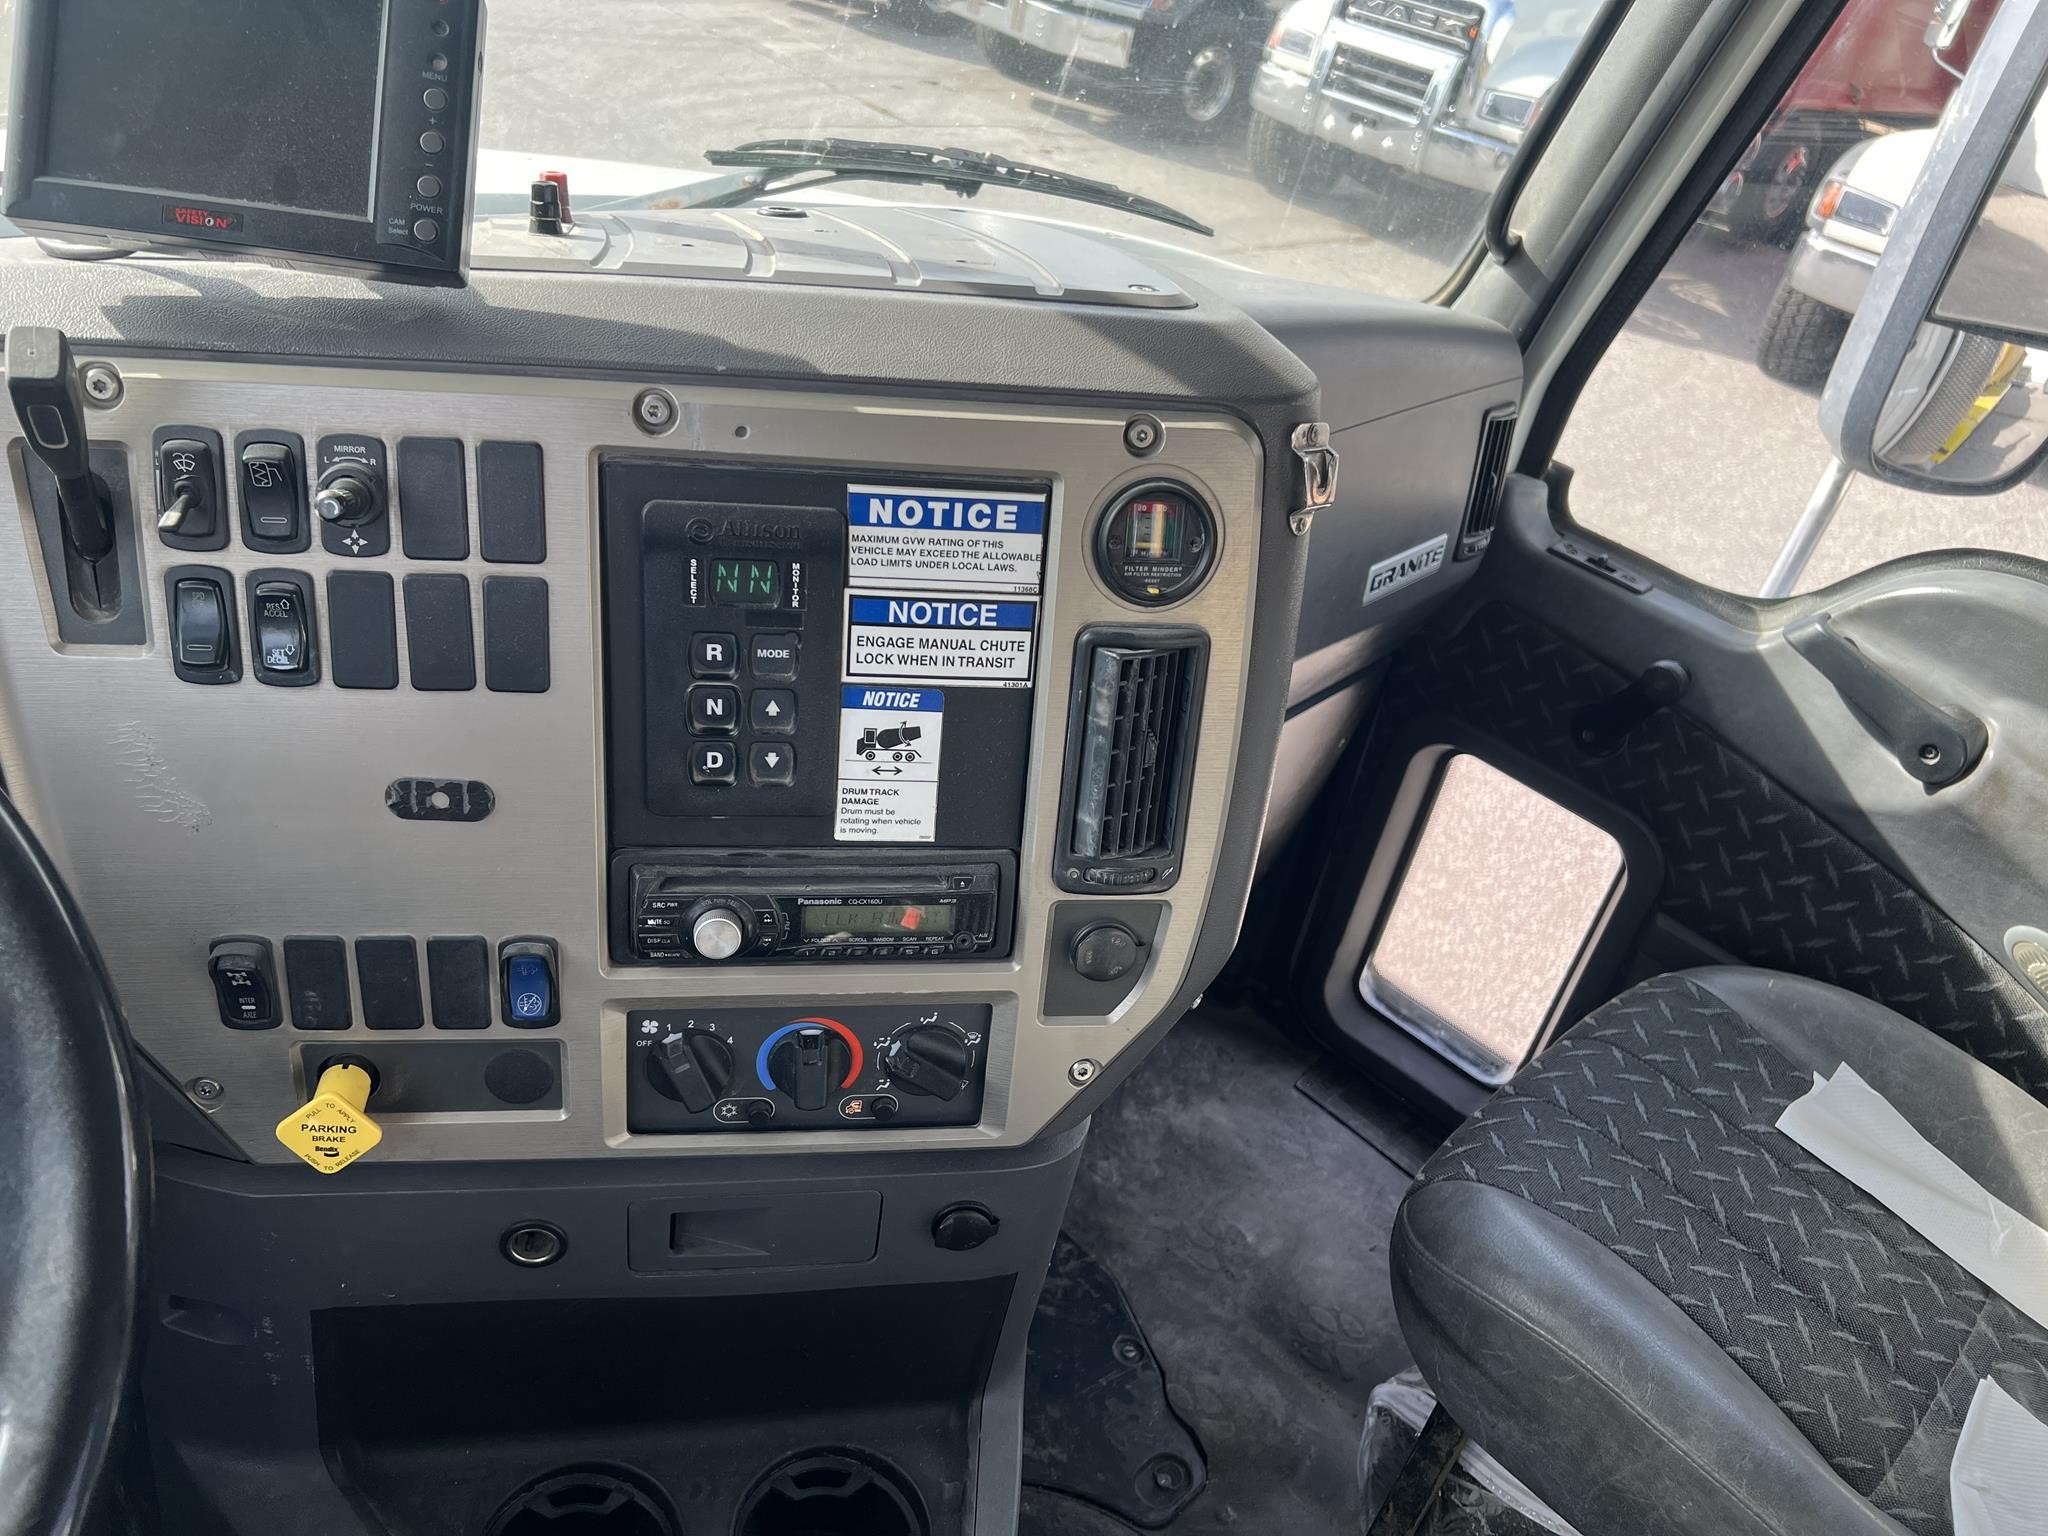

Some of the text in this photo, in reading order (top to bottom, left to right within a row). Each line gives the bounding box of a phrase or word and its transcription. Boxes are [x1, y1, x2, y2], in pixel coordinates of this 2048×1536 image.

[422, 71, 448, 82] MENU
[410, 202, 443, 214] POWER
[175, 213, 228, 228] VISION
[388, 217, 406, 225] CAM
[333, 445, 366, 454] MIRROR
[369, 458, 377, 466] R
[868, 498, 1018, 530] NOTICE
[851, 534, 1005, 549] MAXIMUM GVW RATING OF THIS
[851, 546, 1041, 562] VEHICLE MAY EXCEED THE ALLOWABLE
[850, 557, 1017, 573] LOAD LIMITS UNDER LOCAL LAWS.
[1369, 544, 1445, 593] GRANITE
[791, 562, 800, 608] MONITOR
[264, 610, 289, 618] ACCEL
[888, 600, 998, 626] NOTICE
[856, 635, 1026, 652] ENGAGE MANUAL CHUTE
[706, 643, 723, 661] R
[757, 649, 790, 659] MODE
[855, 652, 1016, 669] LOCK WHEN IN TRANSIT
[862, 691, 921, 708] NOTICE
[706, 699, 722, 715] N
[706, 752, 723, 769] D
[842, 787, 900, 796] DRUM TRACK
[841, 797, 880, 805] DAMAGE
[841, 807, 863, 815] Drum
[840, 818, 870, 826] rotating
[797, 897, 842, 905] Panasonic
[243, 1011, 257, 1019] AXLE
[666, 1023, 671, 1031] 1
[687, 1020, 695, 1028] 2
[709, 1023, 716, 1031] 3
[726, 1036, 734, 1044] 4
[305, 1108, 322, 1119] PULL
[337, 1109, 357, 1123] APPLY
[301, 1123, 357, 1134] PARKING
[312, 1135, 347, 1143] BRAKE
[304, 1153, 321, 1167] PUSH
[335, 1149, 361, 1167] RELEASE
